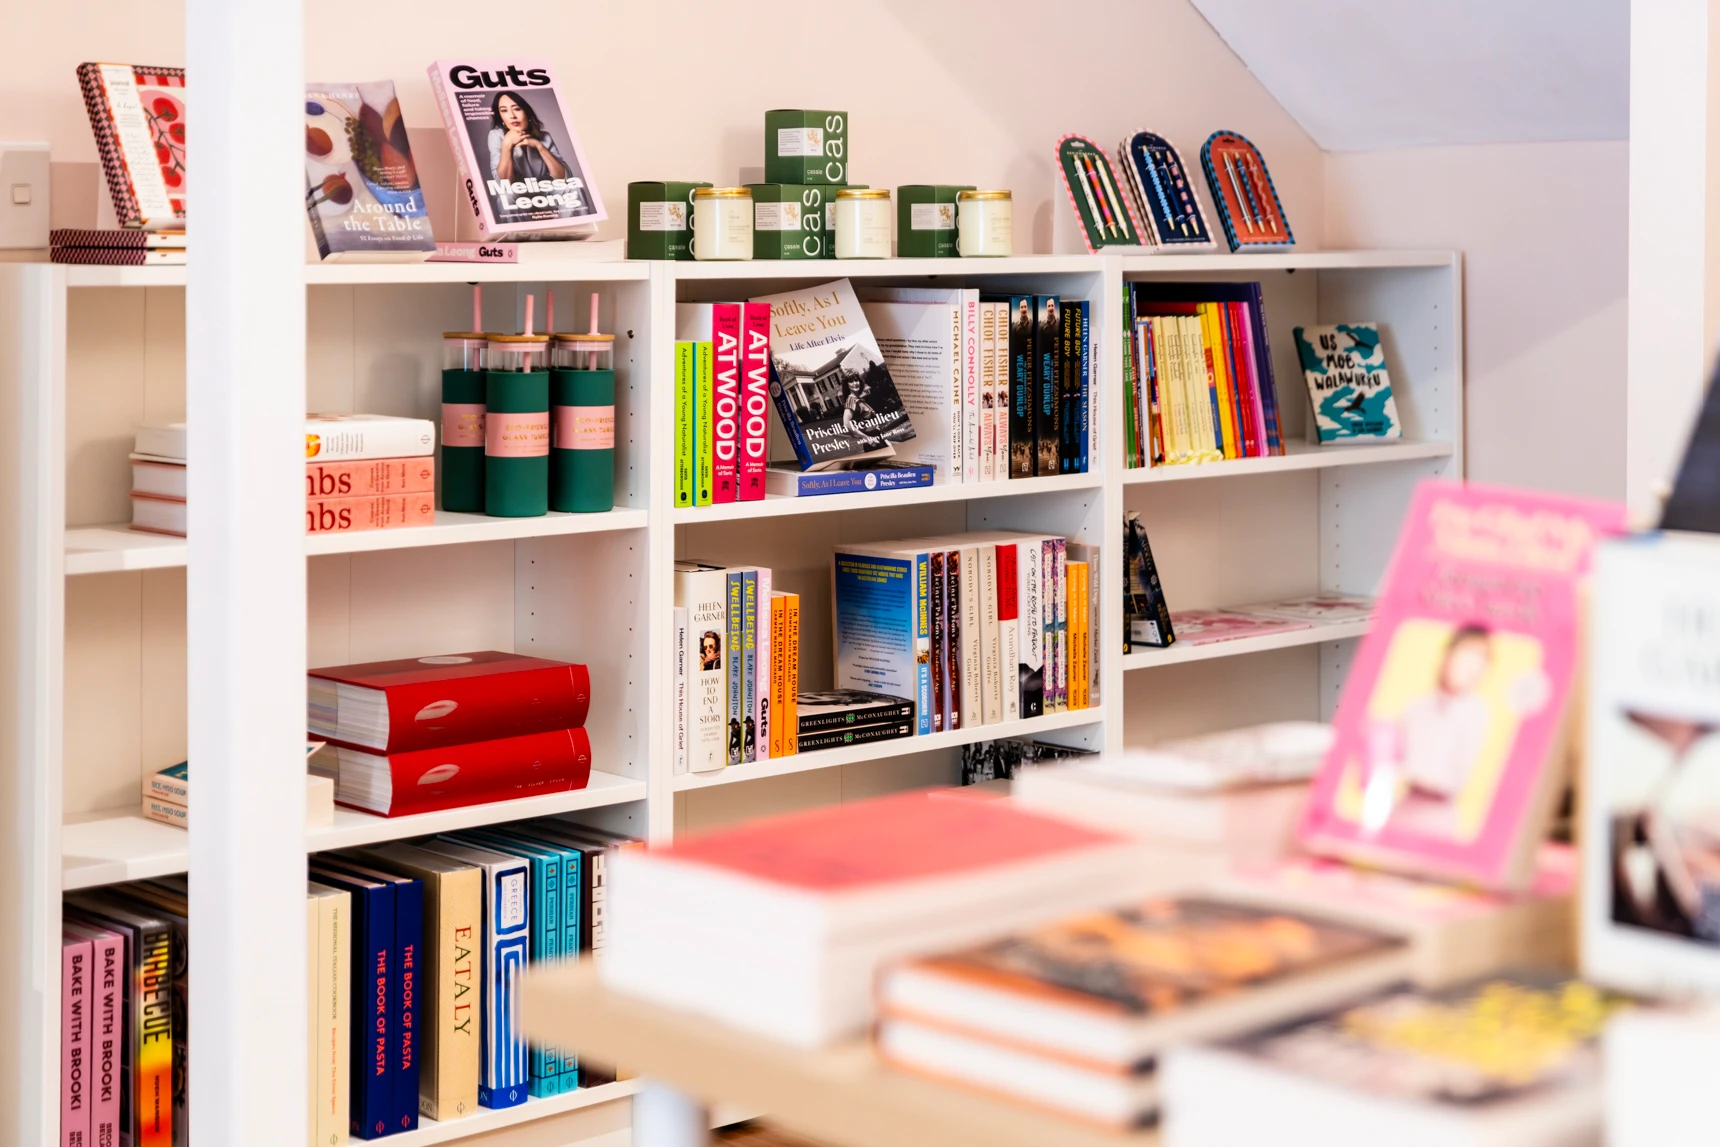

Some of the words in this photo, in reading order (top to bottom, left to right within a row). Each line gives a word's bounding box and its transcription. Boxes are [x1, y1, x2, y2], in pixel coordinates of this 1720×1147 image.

[449, 65, 551, 89] Guts
[466, 178, 481, 217] Guts
[486, 177, 584, 197] Melissa
[500, 190, 582, 210] Leong
[353, 197, 418, 214] Around
[344, 217, 372, 232] the
[373, 215, 422, 231] Table
[445, 245, 476, 260] Leong
[479, 246, 504, 258] Guts
[769, 298, 812, 320] Softly,
[813, 295, 831, 312] As
[832, 291, 841, 306] I
[967, 301, 976, 334] BILLY
[774, 318, 817, 338] Leave
[816, 314, 847, 331] You
[983, 310, 993, 342] CHLOE
[998, 309, 1008, 342] CHLOE
[789, 340, 805, 351] Life
[806, 336, 826, 349] After
[826, 333, 845, 345] Elvis
[1319, 333, 1337, 351] US
[967, 338, 976, 406] CONNOLLY
[983, 349, 993, 387] FISHER
[998, 348, 1008, 386] FISHER
[1016, 354, 1024, 382] WEARY
[1043, 352, 1051, 381] WEARY
[1326, 354, 1355, 369] MOB
[715, 331, 738, 461] ATWOOD
[745, 329, 768, 458] ATWOOD
[1016, 385, 1024, 417] DUNLOP
[1043, 383, 1051, 415] DUNLOP
[806, 421, 850, 442] Priscilla
[849, 409, 900, 431] Beaulieu
[984, 413, 993, 445] ALWAYS
[999, 411, 1008, 444] ALWAYS
[811, 437, 850, 456] Presley
[801, 479, 822, 490] Softly,
[821, 479, 830, 488] As
[833, 477, 850, 487] Leave
[851, 477, 862, 486] You
[880, 472, 898, 480] Priscilla
[898, 471, 917, 480] Beaulieu
[880, 479, 896, 488] Presley
[919, 561, 928, 597] WILLIAM
[1031, 568, 1037, 578] ON
[694, 611, 725, 623] GARNER
[698, 602, 722, 612] HELEN
[730, 581, 740, 652] SWELLBEING
[745, 579, 755, 650] SWELLBEING
[760, 577, 770, 641] Melissa
[778, 609, 783, 617] IN
[793, 608, 798, 616] IN
[934, 607, 942, 639] Parsons
[1031, 616, 1038, 627] TO
[1008, 625, 1016, 673] Arundhati
[701, 677, 720, 687] HOW
[759, 641, 769, 693] Leong
[703, 696, 718, 705] END
[706, 686, 715, 696] TO
[746, 679, 754, 714] JOHNSTON
[1007, 675, 1015, 694] Roy
[699, 714, 721, 724] STORY
[708, 706, 714, 714] A
[760, 697, 769, 738] Guts
[800, 716, 845, 727] GREENLIGHTS
[856, 709, 900, 720] McCONAUGHEY
[799, 736, 843, 747] GREENLIGHTS
[854, 728, 898, 739] McCONAUGHEY
[510, 879, 518, 922] GREECE
[103, 947, 115, 989] BAKE
[377, 949, 386, 975] THE
[403, 944, 413, 969] THE
[71, 954, 83, 996] BAKE
[143, 930, 171, 1045] BARBECUE
[403, 972, 413, 1010] BOOK
[453, 924, 472, 1037] EATALY
[376, 977, 386, 1015] BOOK
[71, 1000, 82, 1043] WITH
[103, 992, 115, 1035] WITH
[376, 1017, 386, 1034] OF
[403, 1012, 412, 1029] OF
[376, 1037, 385, 1076] PASTA
[402, 1032, 412, 1070] PASTA
[70, 1047, 82, 1111] BROOKI
[101, 1040, 113, 1103] BROOKI
